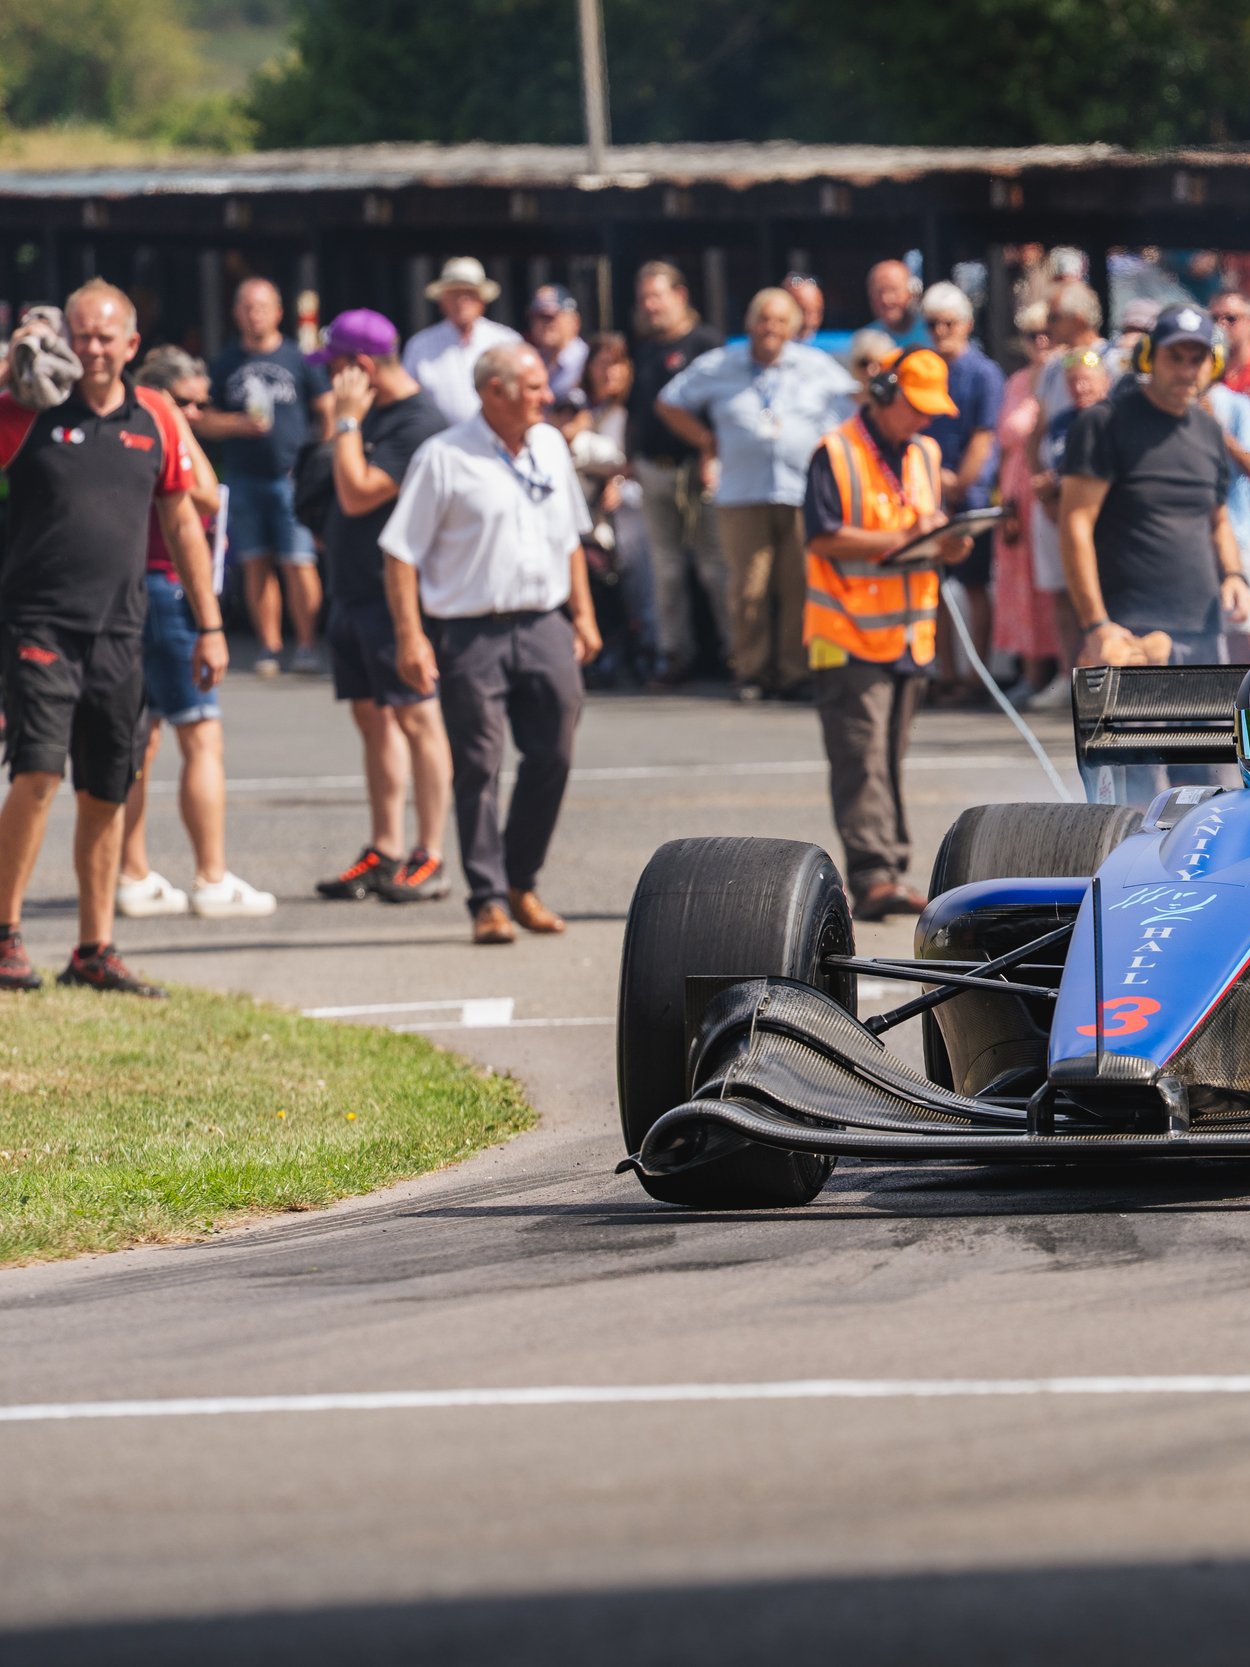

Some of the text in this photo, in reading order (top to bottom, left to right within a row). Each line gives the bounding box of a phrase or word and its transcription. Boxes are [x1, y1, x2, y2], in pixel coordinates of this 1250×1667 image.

[1176, 806, 1236, 881] VANITY
[1120, 927, 1176, 985] HALL
[1075, 996, 1161, 1037] 3
